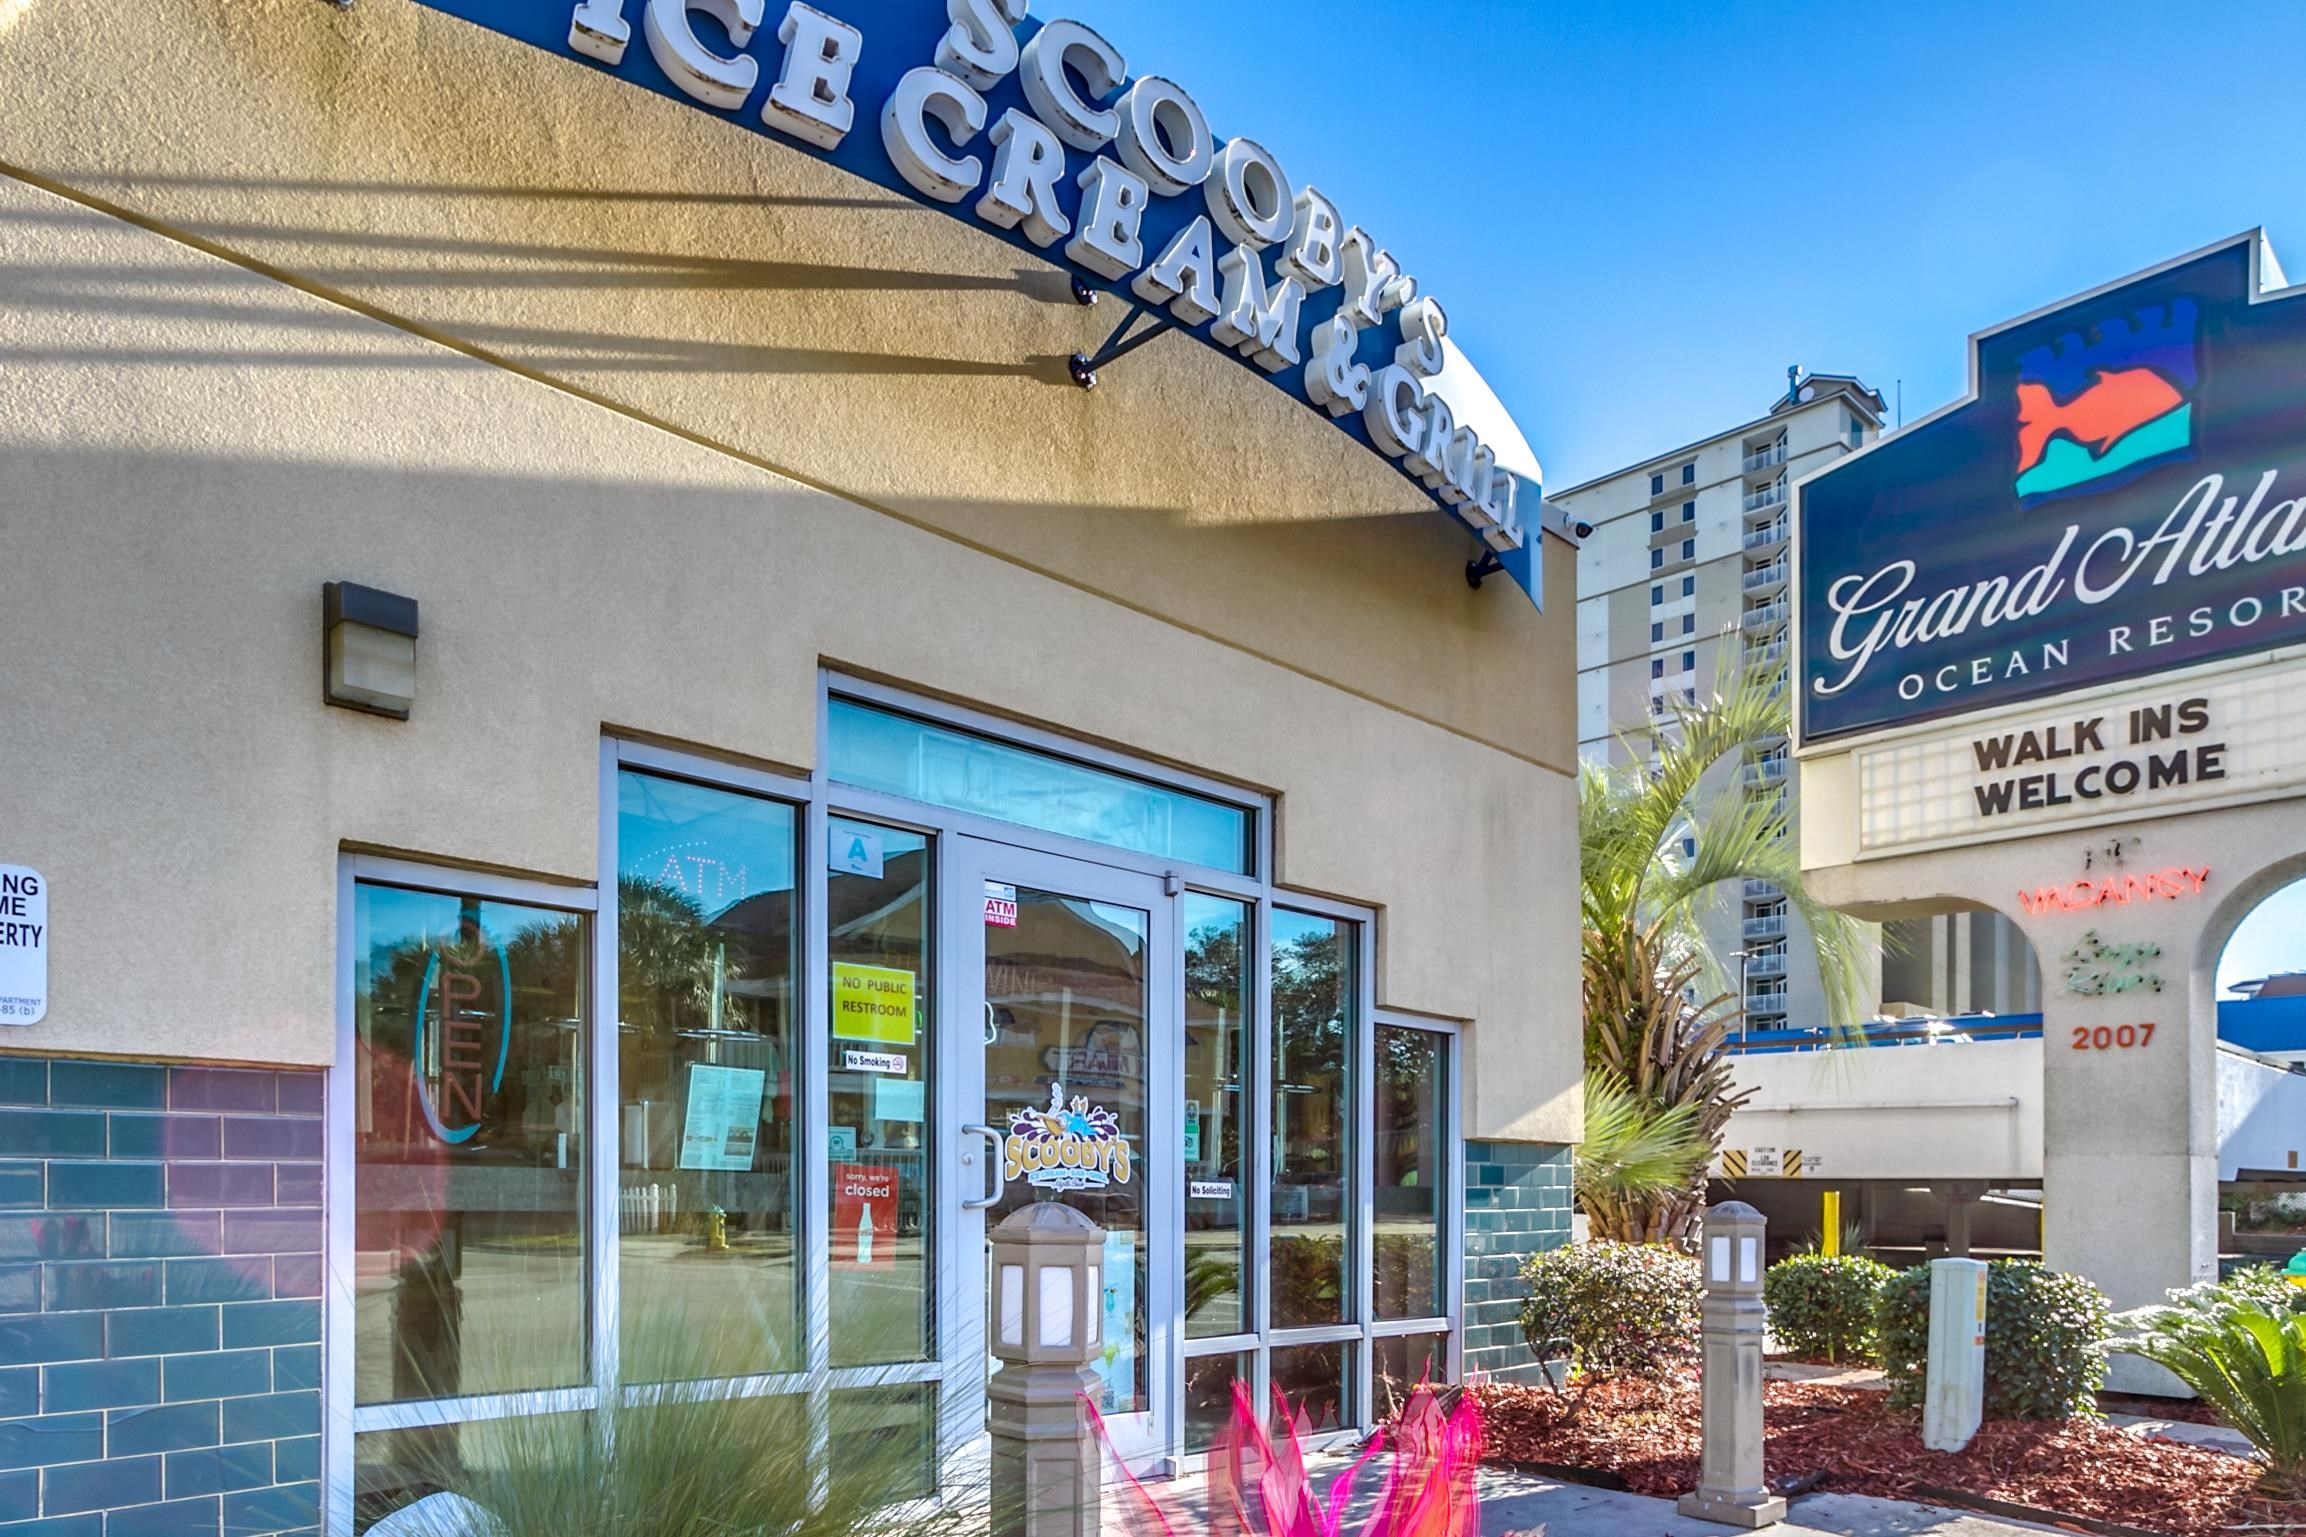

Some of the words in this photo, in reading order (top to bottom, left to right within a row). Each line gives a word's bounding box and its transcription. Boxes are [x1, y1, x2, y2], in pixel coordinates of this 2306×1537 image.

[935, 0, 1448, 379] SCOOBY'S
[881, 66, 1306, 373] CREAM
[1305, 315, 1371, 417] &
[1363, 362, 1523, 552] GRILL
[1814, 525, 2079, 695] Grand
[1899, 640, 2069, 699] OCEAN
[1973, 717, 2104, 771] WALK
[2129, 698, 2209, 745] INS
[1974, 743, 2226, 816] WELCOME
[847, 838, 867, 862] A
[654, 853, 746, 900] ATM
[2018, 866, 2211, 915] VACANCY
[985, 900, 1015, 916] ATM
[985, 913, 1016, 926] INSIDE
[842, 977, 861, 989] NO
[867, 980, 907, 994] PUBLIC
[842, 1000, 907, 1017] RESTROOM
[2071, 1023, 2155, 1050] 2007
[848, 1054, 858, 1065] No
[860, 1056, 890, 1070] Smoking
[1005, 1136, 1130, 1182] SCOOBY'S
[845, 1184, 890, 1198] closed
[1192, 1186, 1200, 1194] No
[1202, 1186, 1230, 1197] Soliciting
